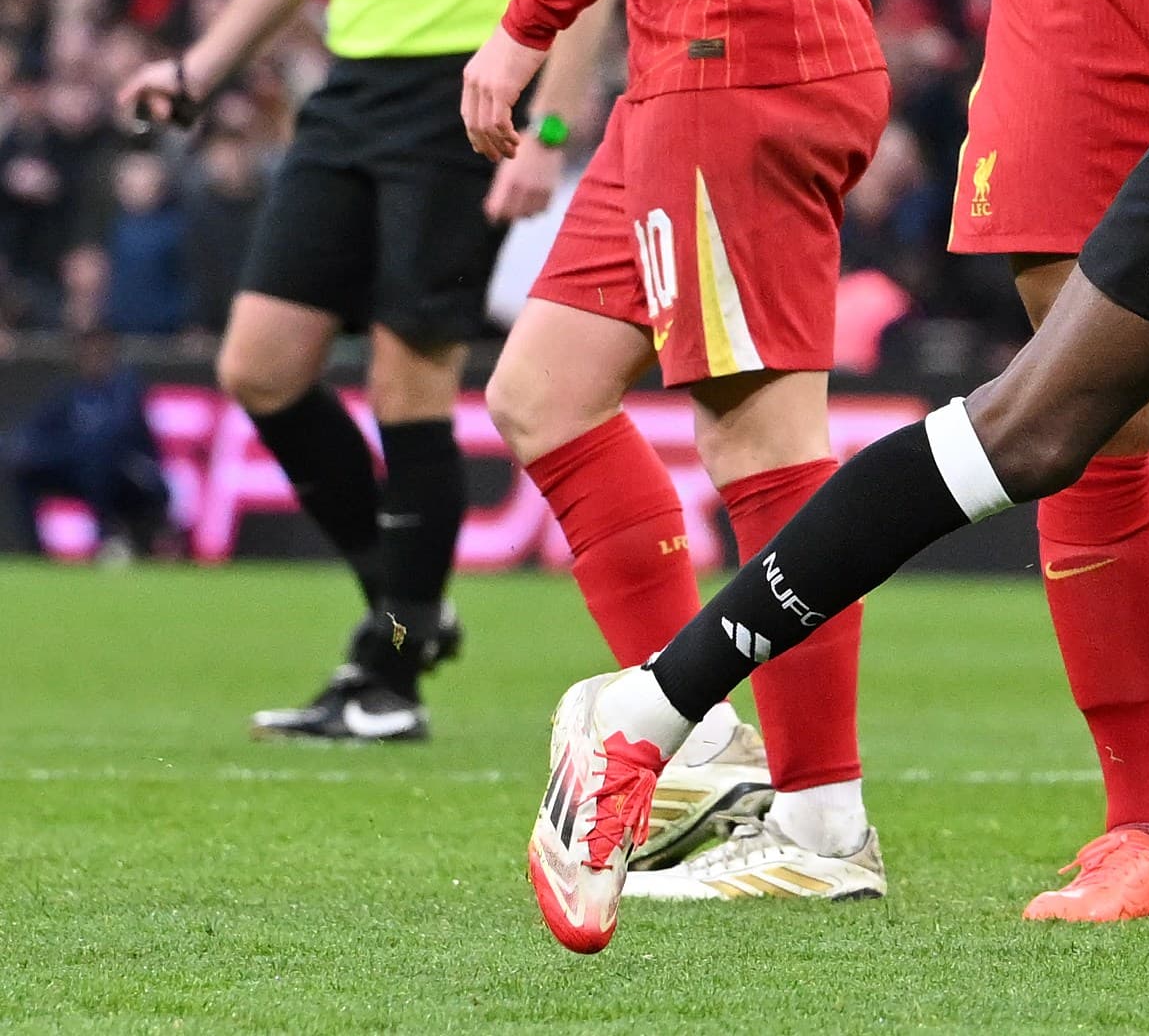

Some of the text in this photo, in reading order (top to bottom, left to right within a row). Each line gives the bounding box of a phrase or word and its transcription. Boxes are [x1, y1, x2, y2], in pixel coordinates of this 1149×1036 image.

[971, 202, 993, 217] LFC
[634, 207, 678, 319] 10
[762, 550, 828, 627] NUFC
